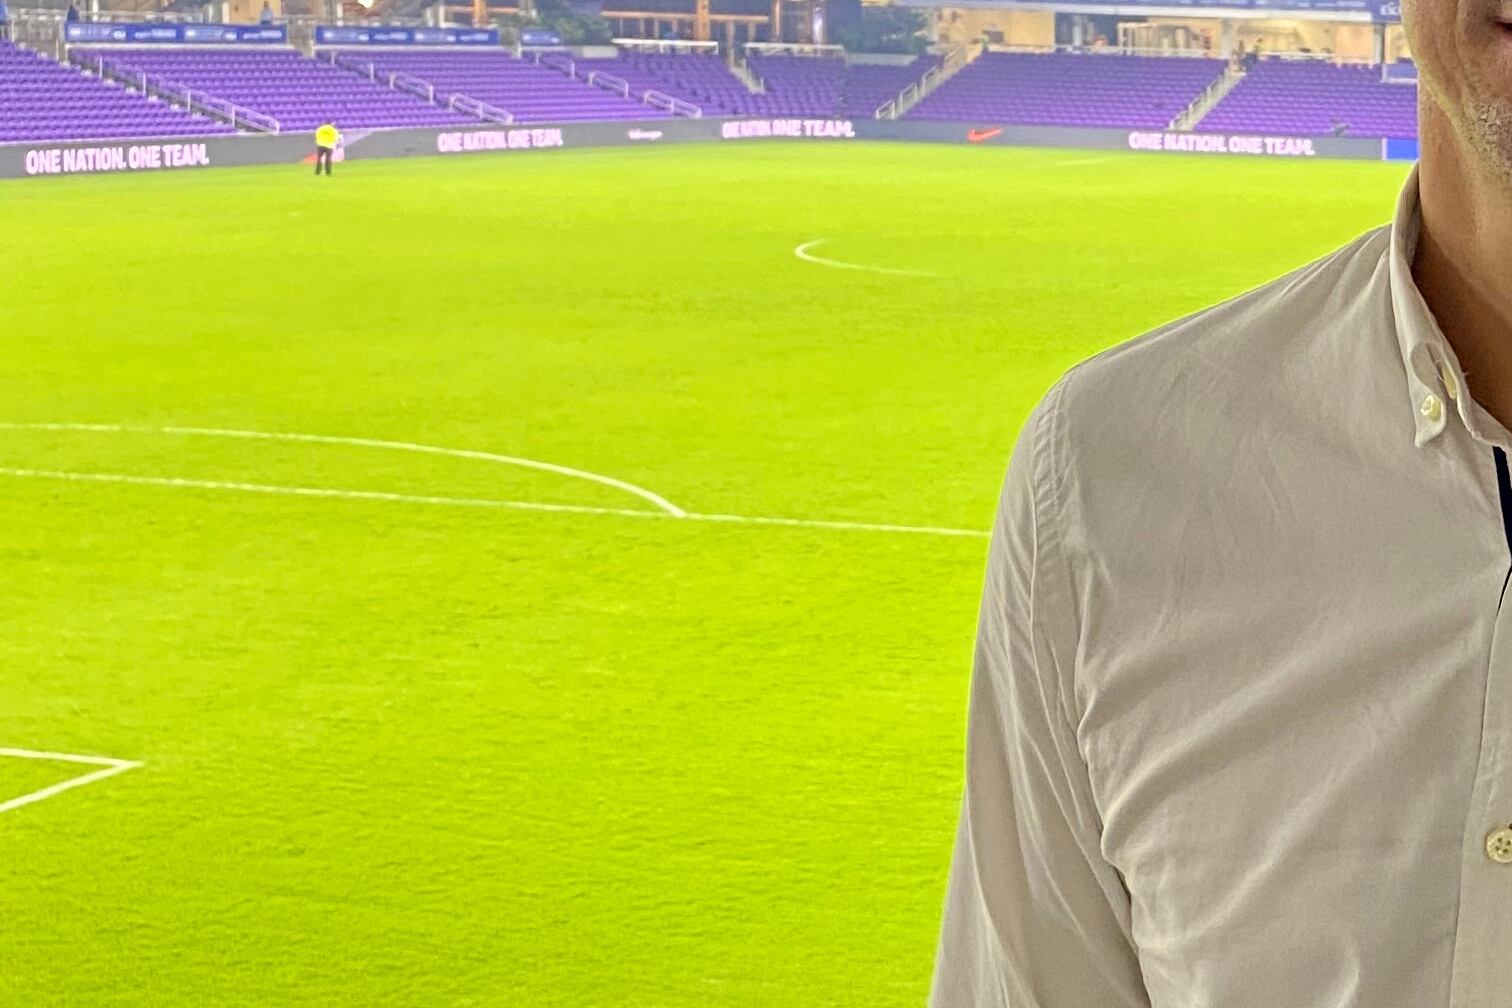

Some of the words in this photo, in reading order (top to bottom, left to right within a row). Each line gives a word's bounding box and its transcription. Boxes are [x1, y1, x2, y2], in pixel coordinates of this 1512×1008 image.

[803, 119, 856, 138] TEAM.
[1128, 132, 1164, 150] ONE
[1228, 135, 1263, 154] ONE
[1264, 137, 1316, 156] TEAM.
[25, 149, 62, 175] ONE
[63, 146, 127, 173] NATION.
[128, 145, 162, 169] ONE
[162, 143, 210, 168] TEAM.
